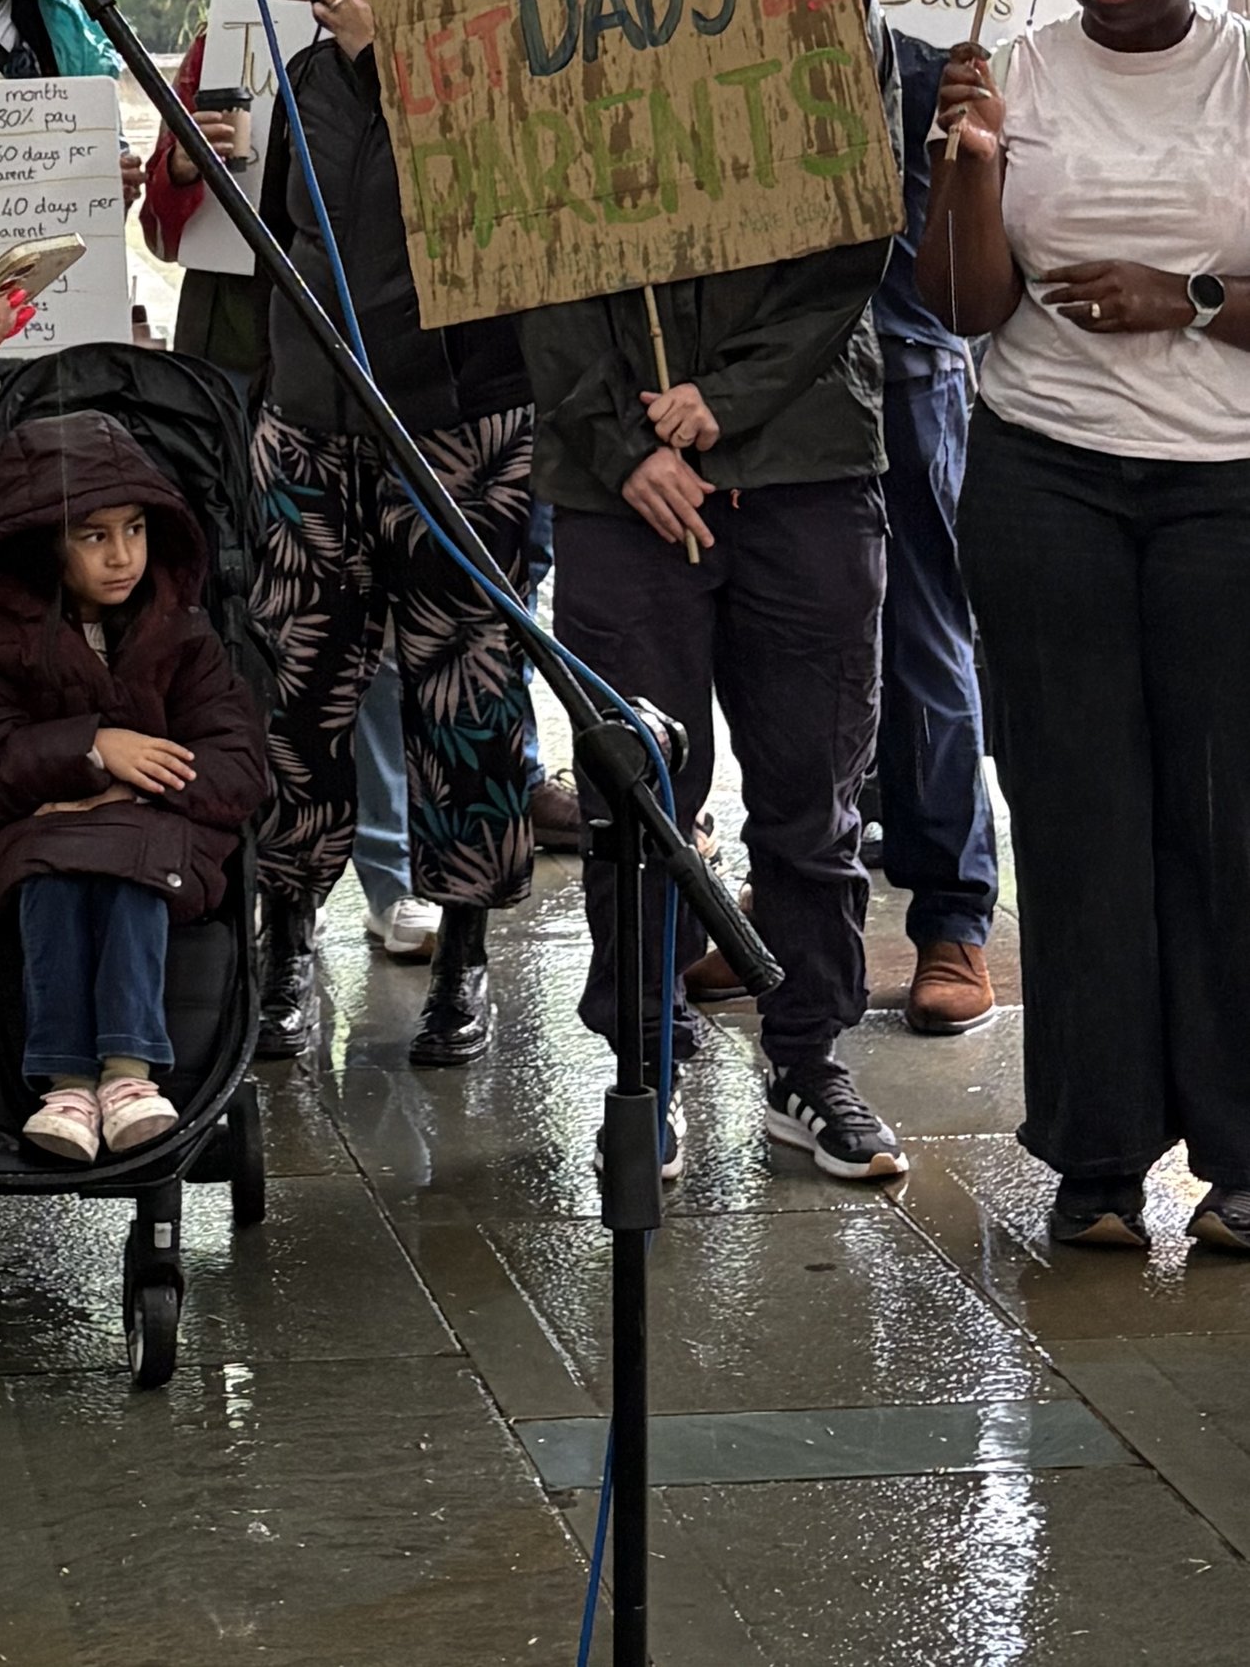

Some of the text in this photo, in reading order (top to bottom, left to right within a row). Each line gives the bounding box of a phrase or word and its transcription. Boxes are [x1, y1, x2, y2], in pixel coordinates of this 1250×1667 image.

[394, 5, 512, 117] LET
[4, 82, 70, 103] months
[44, 111, 78, 133] pay
[22, 145, 61, 171] days
[68, 144, 98, 165] per
[407, 47, 870, 260] PARENTS
[34, 194, 78, 224] days
[88, 197, 120, 218] per
